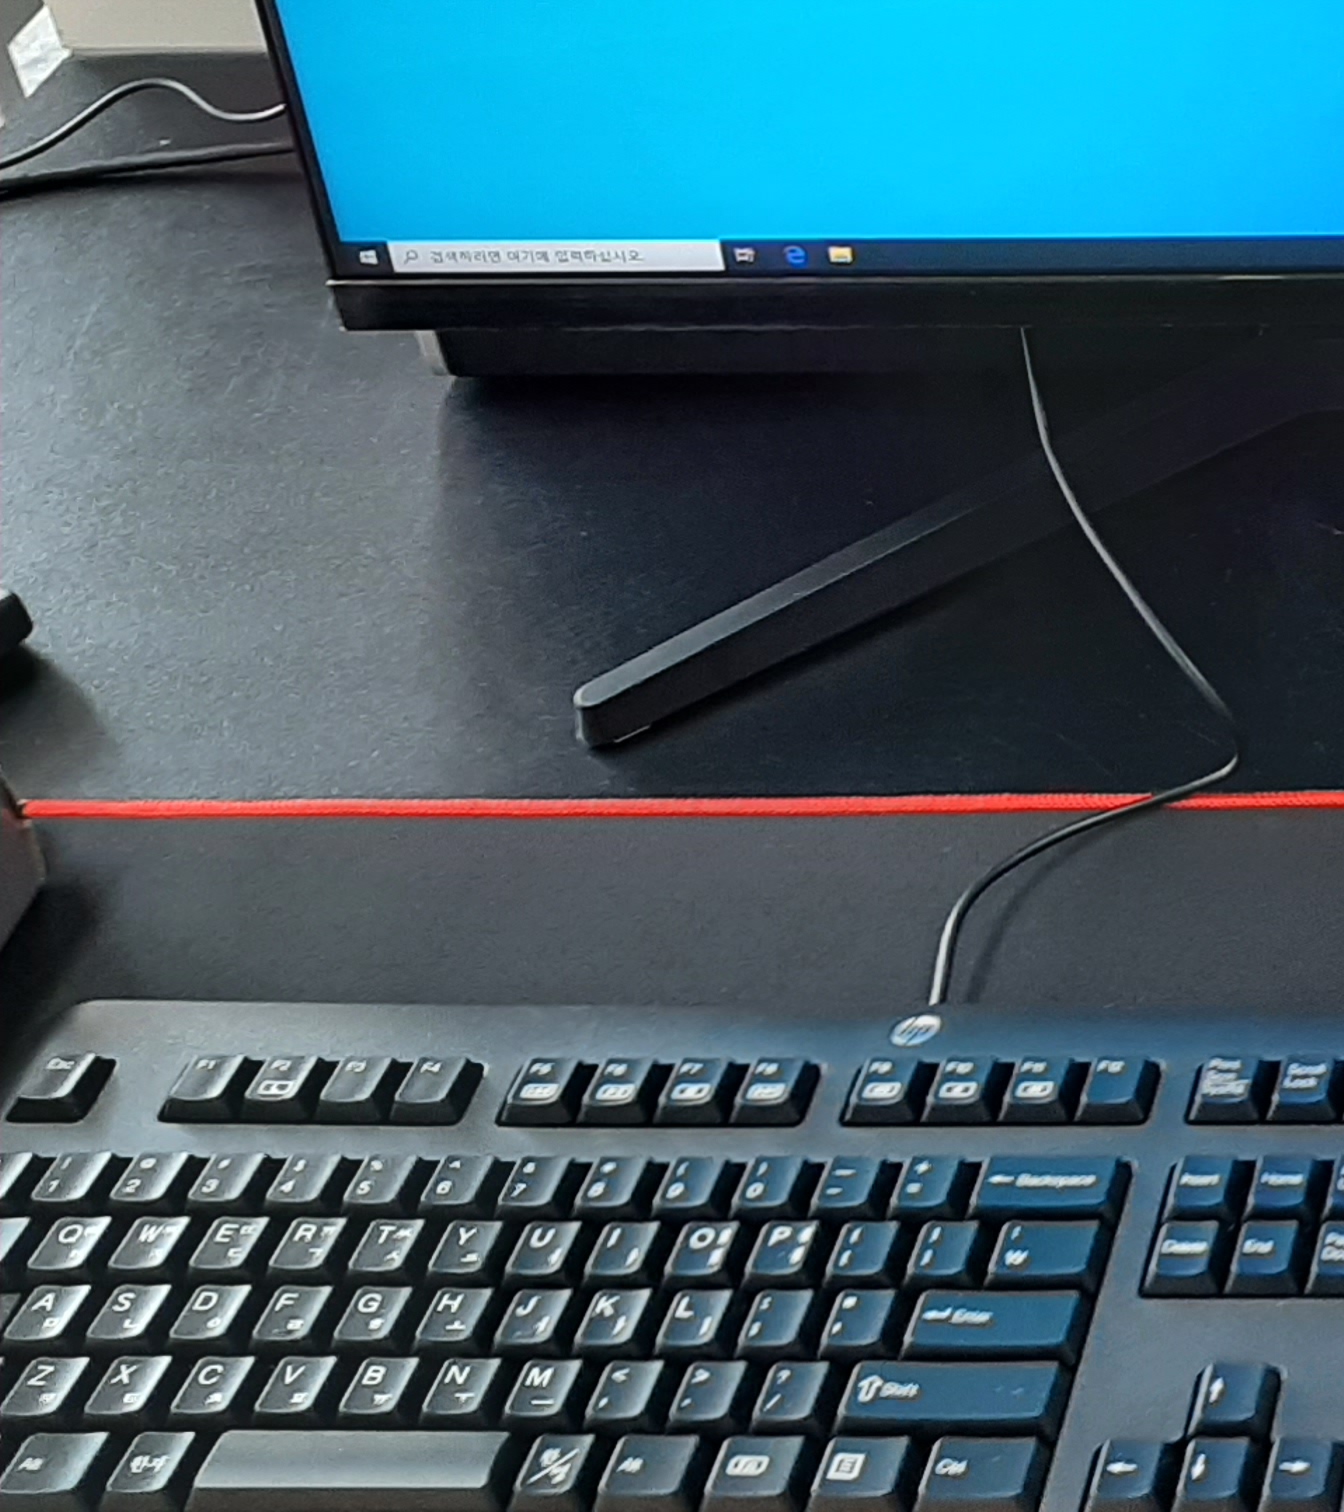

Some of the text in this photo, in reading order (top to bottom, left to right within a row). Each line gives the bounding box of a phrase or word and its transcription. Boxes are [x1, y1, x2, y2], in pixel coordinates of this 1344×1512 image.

[58, 1224, 82, 1244] Q
[138, 1224, 161, 1243] W
[214, 1224, 239, 1243] E
[293, 1223, 317, 1242] R
[378, 1225, 397, 1244] T
[457, 1226, 478, 1246] Y
[529, 1227, 555, 1248] U
[607, 1227, 622, 1248] I
[689, 1227, 716, 1249] O
[768, 1226, 793, 1247] P
[32, 1292, 56, 1312] A
[112, 1292, 136, 1312] S
[192, 1291, 218, 1311] D
[275, 1292, 299, 1312] F
[357, 1293, 383, 1313] G
[436, 1293, 464, 1313] H
[515, 1295, 541, 1317] J
[596, 1295, 620, 1317] K
[675, 1295, 694, 1318] L
[27, 1365, 55, 1386] Z
[110, 1364, 137, 1385] X
[198, 1364, 224, 1385] C
[283, 1365, 305, 1385] V
[362, 1364, 387, 1385] B
[445, 1365, 471, 1385] N
[525, 1366, 555, 1387] M
